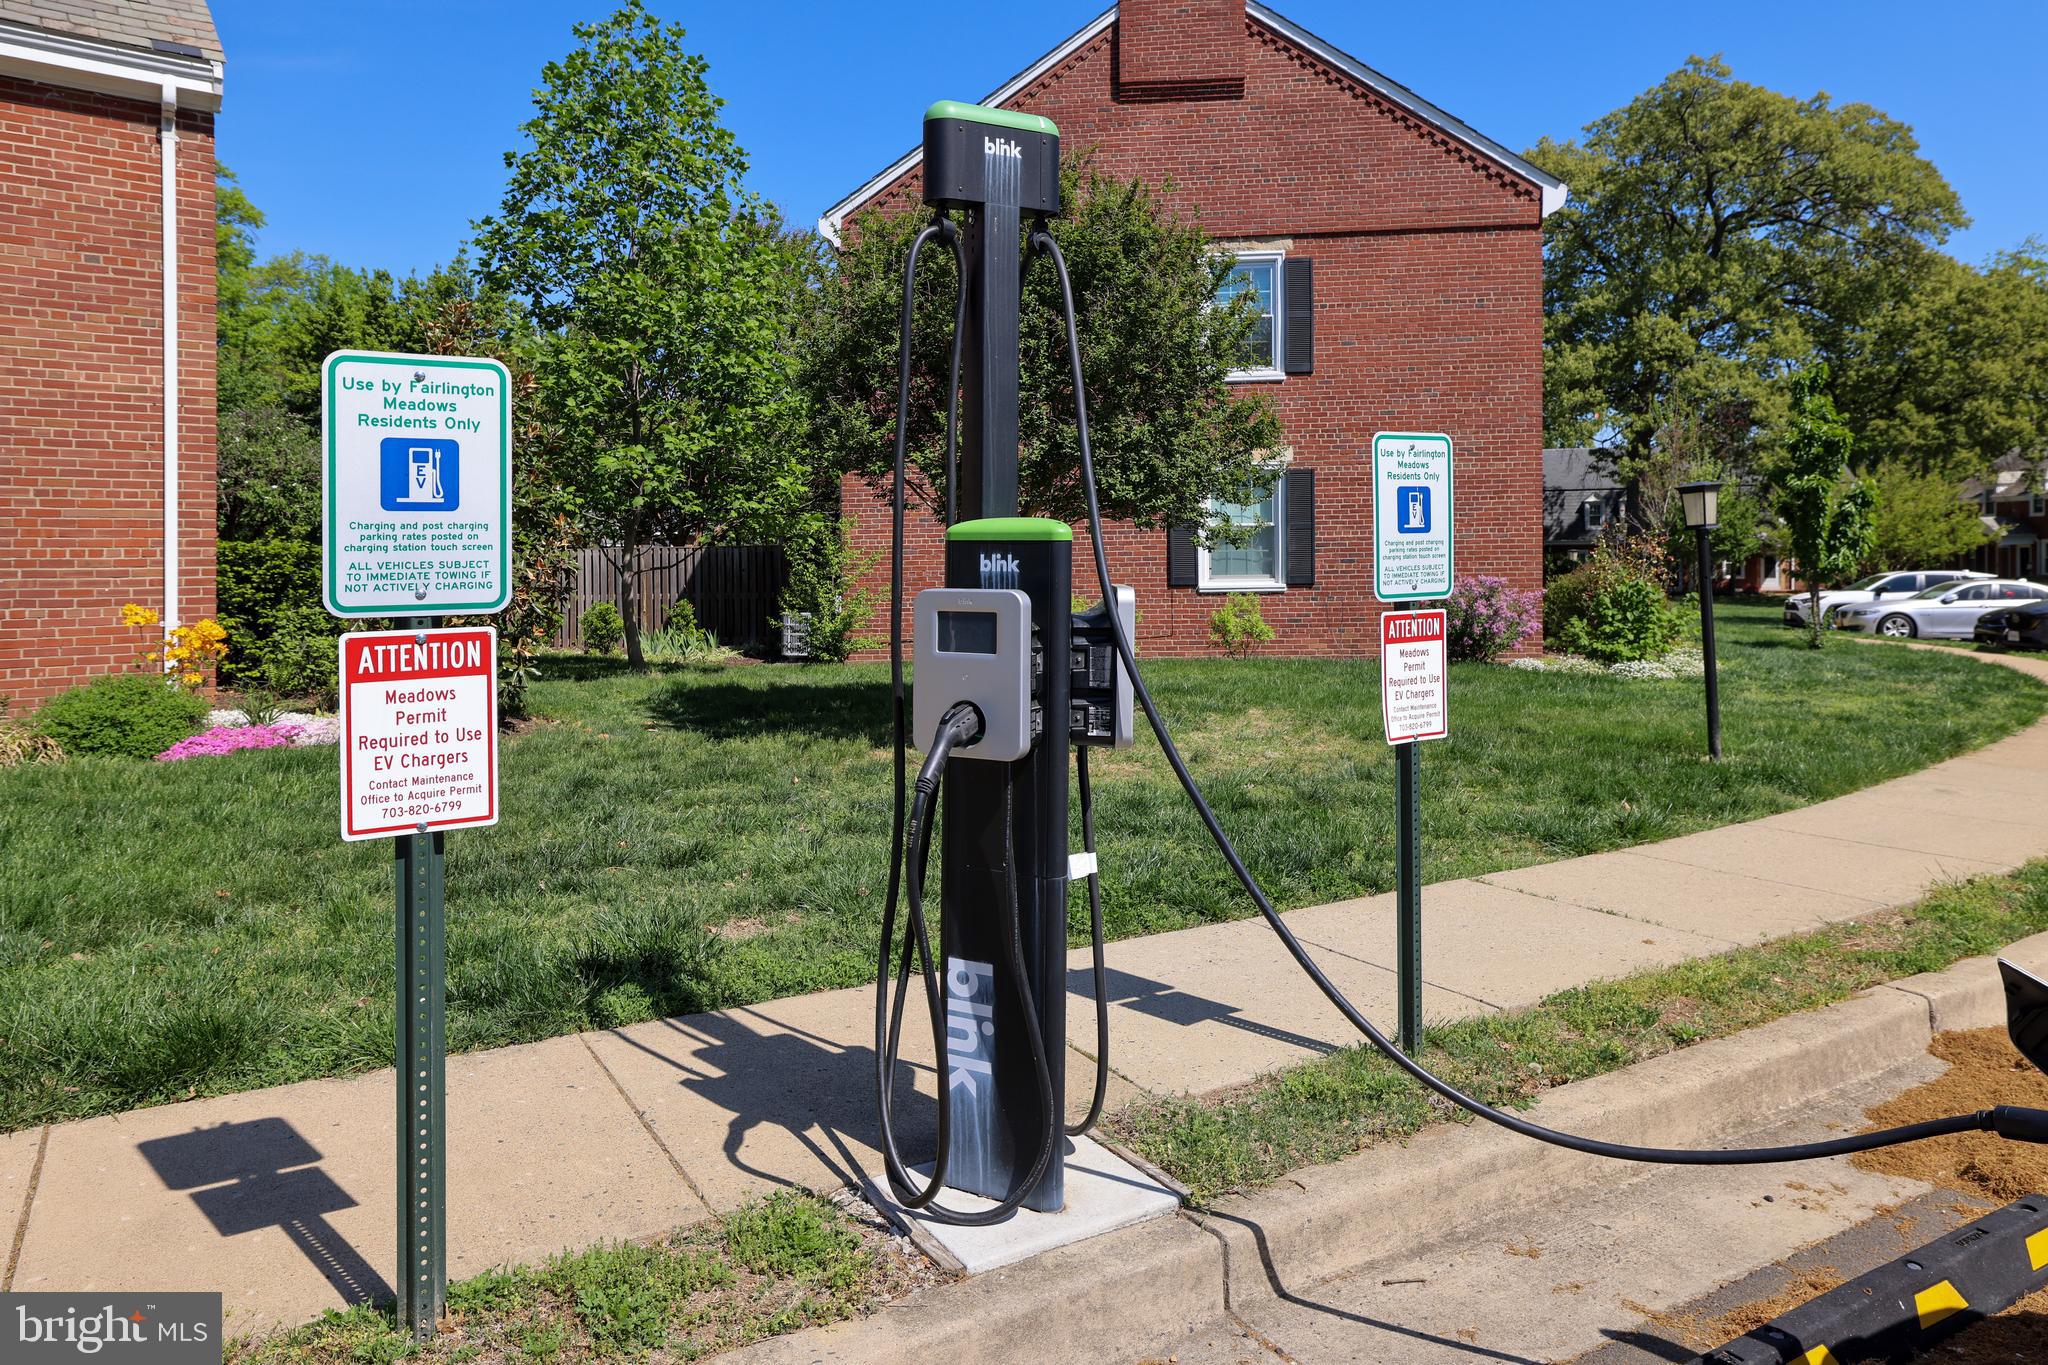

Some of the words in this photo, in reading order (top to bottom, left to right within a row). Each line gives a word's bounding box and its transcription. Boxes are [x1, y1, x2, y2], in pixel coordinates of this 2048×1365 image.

[985, 136, 1021, 158] blink
[342, 377, 374, 391] Use
[382, 379, 401, 395] by
[410, 381, 494, 399] Fairlington
[384, 397, 457, 412] Meadows
[358, 414, 437, 428] Residents
[445, 417, 480, 433] Only
[1380, 448, 1394, 457] Use
[1397, 450, 1405, 459] by
[1409, 449, 1445, 460] Fairlington
[1398, 460, 1429, 469] Meadows
[1387, 472, 1421, 480] Residents
[1424, 472, 1440, 482] Only
[349, 522, 395, 532] Charging
[400, 522, 418, 530] and
[422, 522, 443, 532] post
[448, 522, 489, 532] charging
[360, 533, 398, 542] parking
[432, 533, 462, 542] posted
[344, 543, 388, 554] charging
[393, 543, 426, 551] station
[431, 543, 457, 551] touch
[462, 543, 493, 551] screen
[377, 561, 434, 570] VEHICLES
[439, 561, 489, 569] SUBJECT
[980, 554, 1020, 573] blink
[347, 573, 362, 582] TO
[367, 572, 430, 581] IMMEDIATE
[435, 571, 477, 580] TOWING
[481, 571, 491, 579] IF
[345, 584, 369, 592] NOT
[373, 582, 429, 591] ACTIVELY
[435, 582, 492, 590] CHARGING
[1389, 618, 1440, 638] ATTENTION
[358, 640, 481, 674] ATTENTION
[1400, 648, 1429, 658] Meadows
[1404, 662, 1425, 671] Permit
[1389, 676, 1418, 688] Required
[1420, 676, 1426, 684] to
[1429, 674, 1440, 683] Use
[386, 688, 456, 704] Meadows
[1395, 691, 1404, 700] EV
[1406, 689, 1434, 700] Chargers
[396, 708, 447, 725] Permit
[359, 731, 428, 751] Required
[435, 730, 449, 743] to
[457, 727, 482, 741] Use
[374, 755, 394, 771] EV
[401, 752, 468, 769] Chargers
[369, 777, 408, 790] Contact
[412, 772, 474, 786] Maintenance
[361, 795, 390, 805] Office
[394, 793, 403, 801] to
[408, 787, 445, 801] Acquire
[450, 785, 482, 795] Permit
[382, 801, 462, 818] 703-820-6799
[947, 957, 994, 1099] blink
